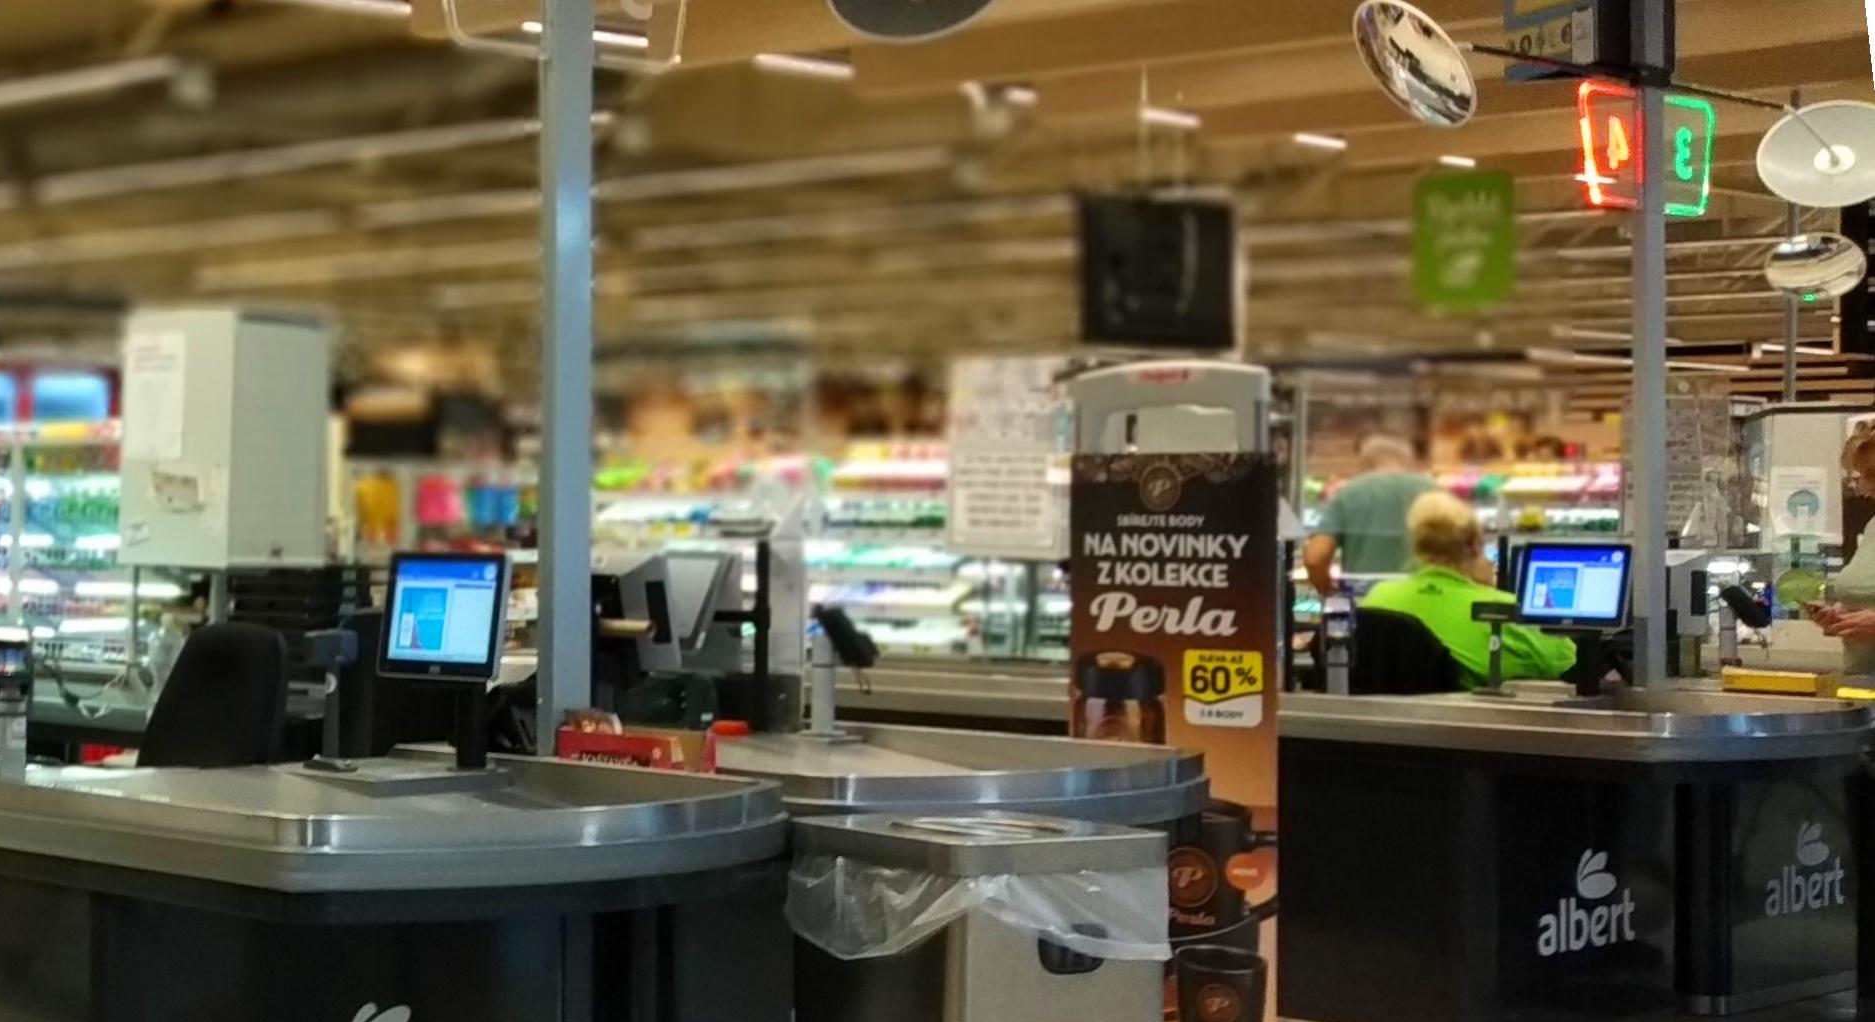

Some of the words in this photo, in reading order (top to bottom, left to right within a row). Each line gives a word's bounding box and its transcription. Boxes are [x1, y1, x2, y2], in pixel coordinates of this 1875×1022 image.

[1168, 513, 1205, 528] BODY
[1084, 532, 1118, 556] NA
[1121, 532, 1250, 559] NOVINKY
[1097, 561, 1113, 585] Z
[1115, 561, 1229, 588] KOLEKCE
[1089, 591, 1238, 637] Perla
[1765, 857, 1845, 917] albert
[1537, 888, 1637, 957] albert
